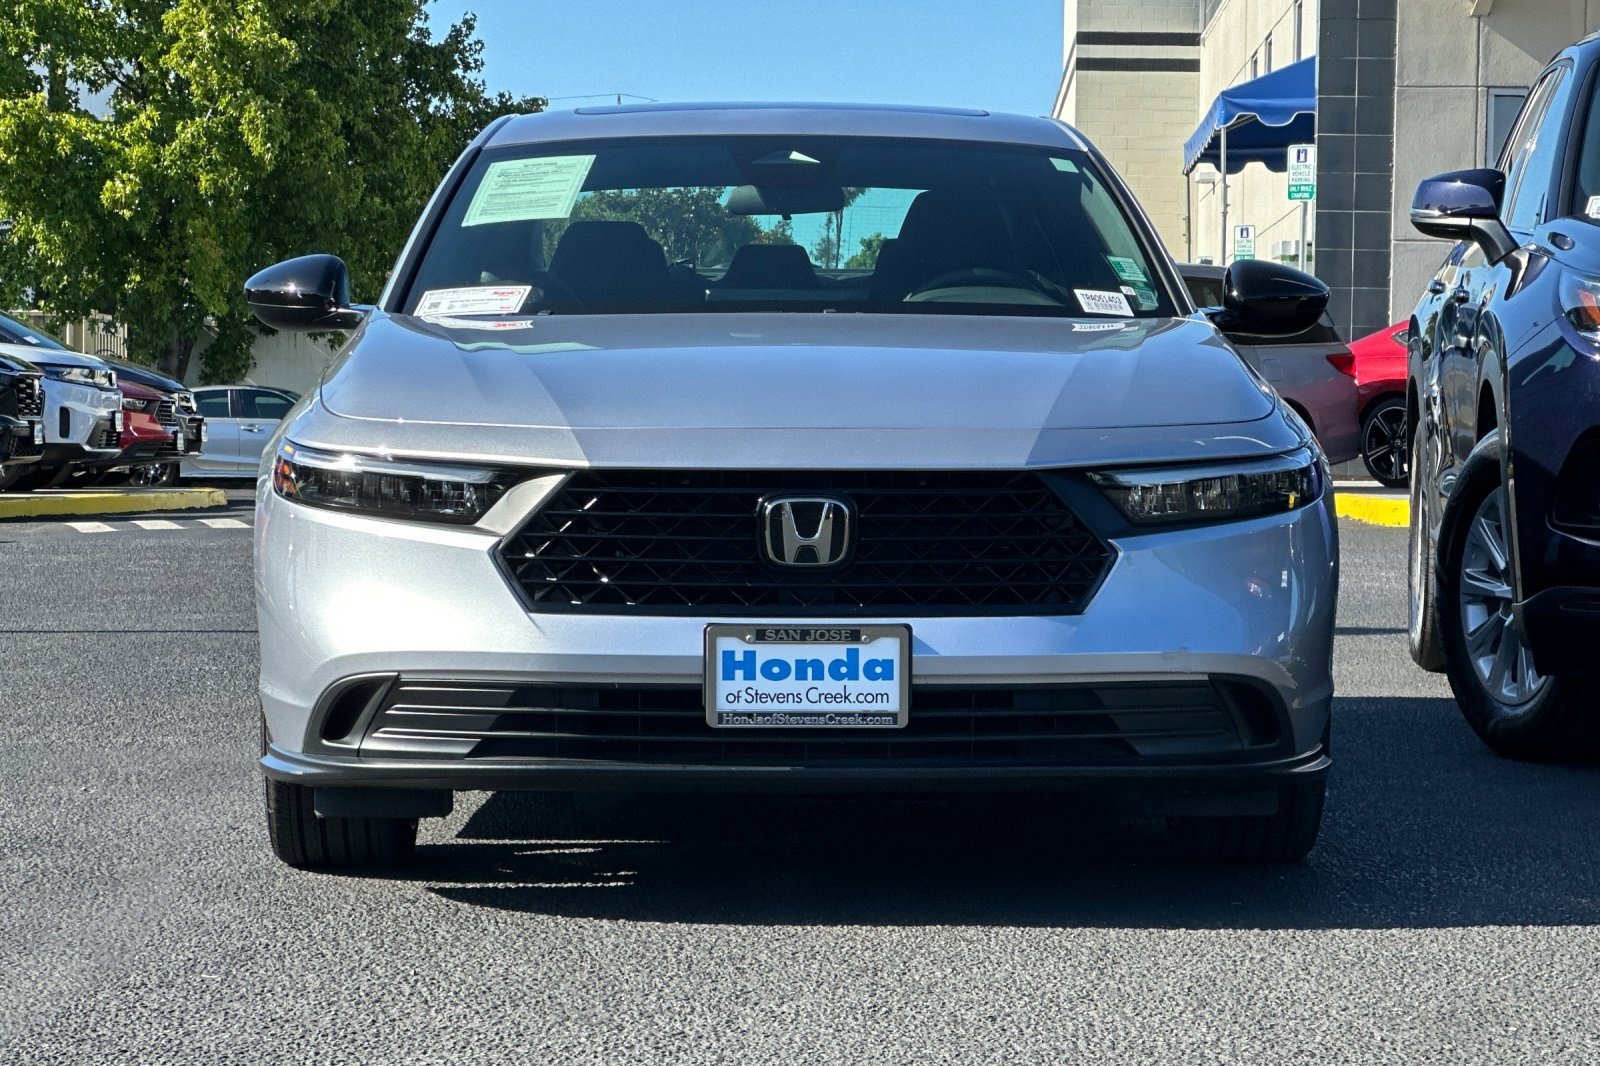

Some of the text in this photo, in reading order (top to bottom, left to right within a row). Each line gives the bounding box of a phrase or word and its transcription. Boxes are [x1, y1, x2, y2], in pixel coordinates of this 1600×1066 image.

[765, 630, 852, 641] SAN JOSE
[722, 648, 894, 682] Honda
[726, 684, 889, 704] of Stevens Creek.com
